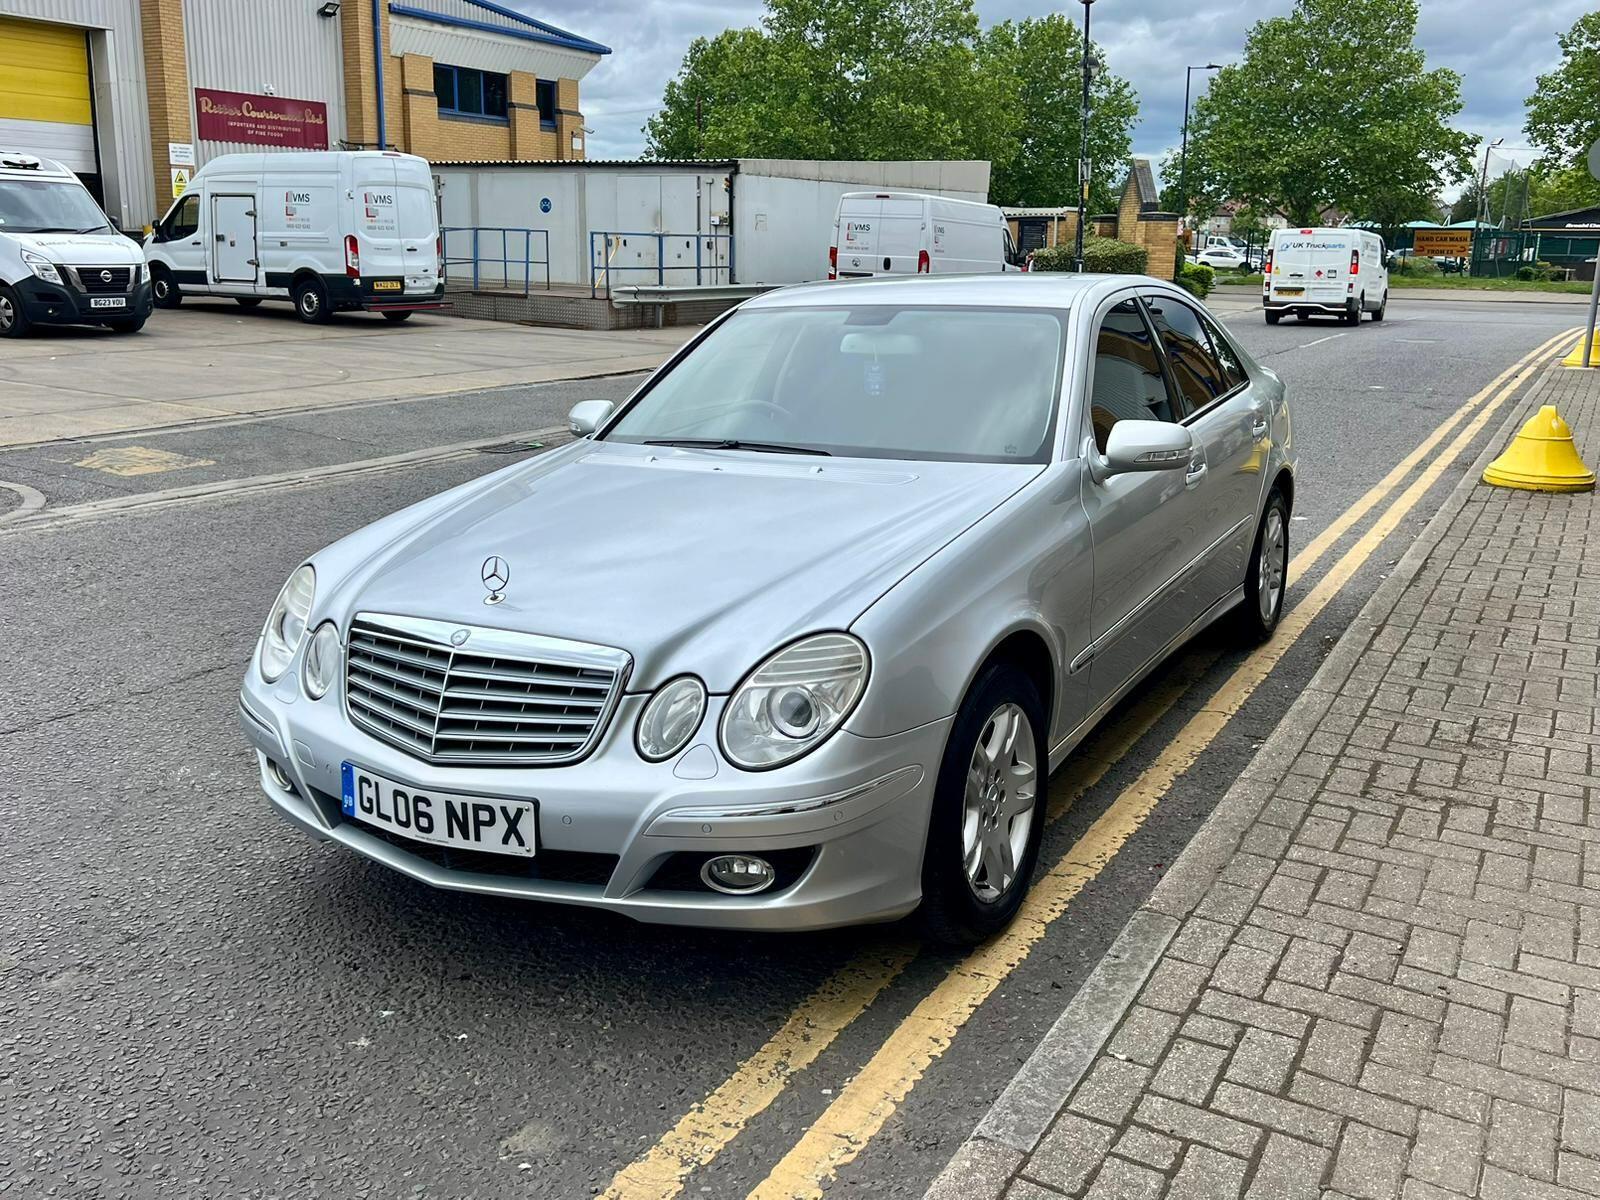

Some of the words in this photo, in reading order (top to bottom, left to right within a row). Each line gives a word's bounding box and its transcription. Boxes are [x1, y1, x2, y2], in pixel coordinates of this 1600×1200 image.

[227, 121, 256, 129] IMPORTERS
[267, 124, 301, 133] DISTRIBUTORS
[292, 193, 310, 203] VMS
[372, 194, 392, 204] VMS
[854, 224, 871, 232] VMS
[358, 775, 435, 834] GL06
[444, 799, 526, 847] NPX
